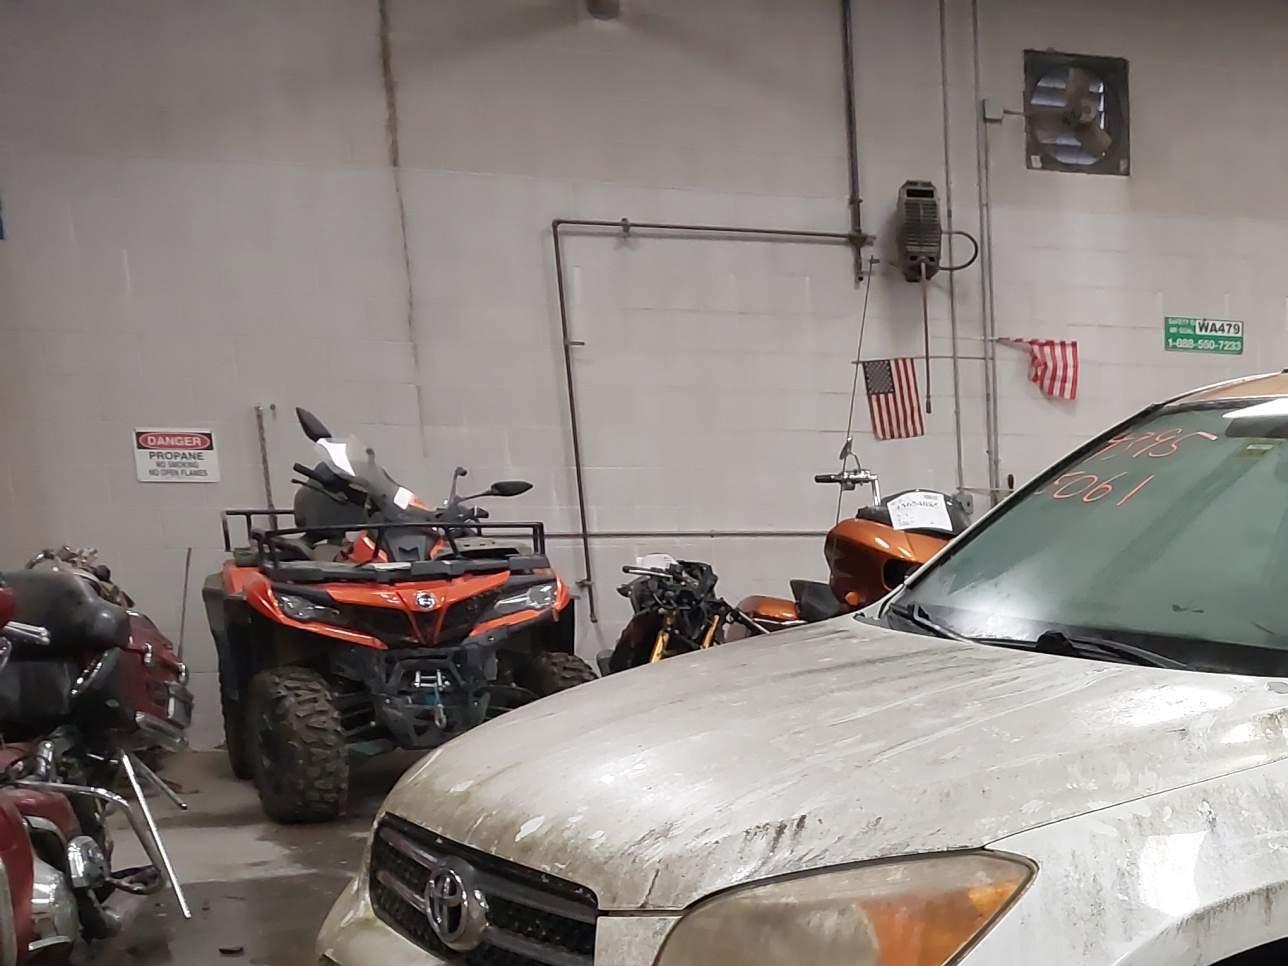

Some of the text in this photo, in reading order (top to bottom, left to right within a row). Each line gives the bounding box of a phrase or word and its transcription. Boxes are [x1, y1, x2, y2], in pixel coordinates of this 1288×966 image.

[1198, 321, 1241, 335] WA479
[147, 436, 202, 446] DANGER
[149, 451, 205, 461] PROPANE
[168, 461, 200, 469] SMOKING
[181, 469, 208, 477] FLAMES
